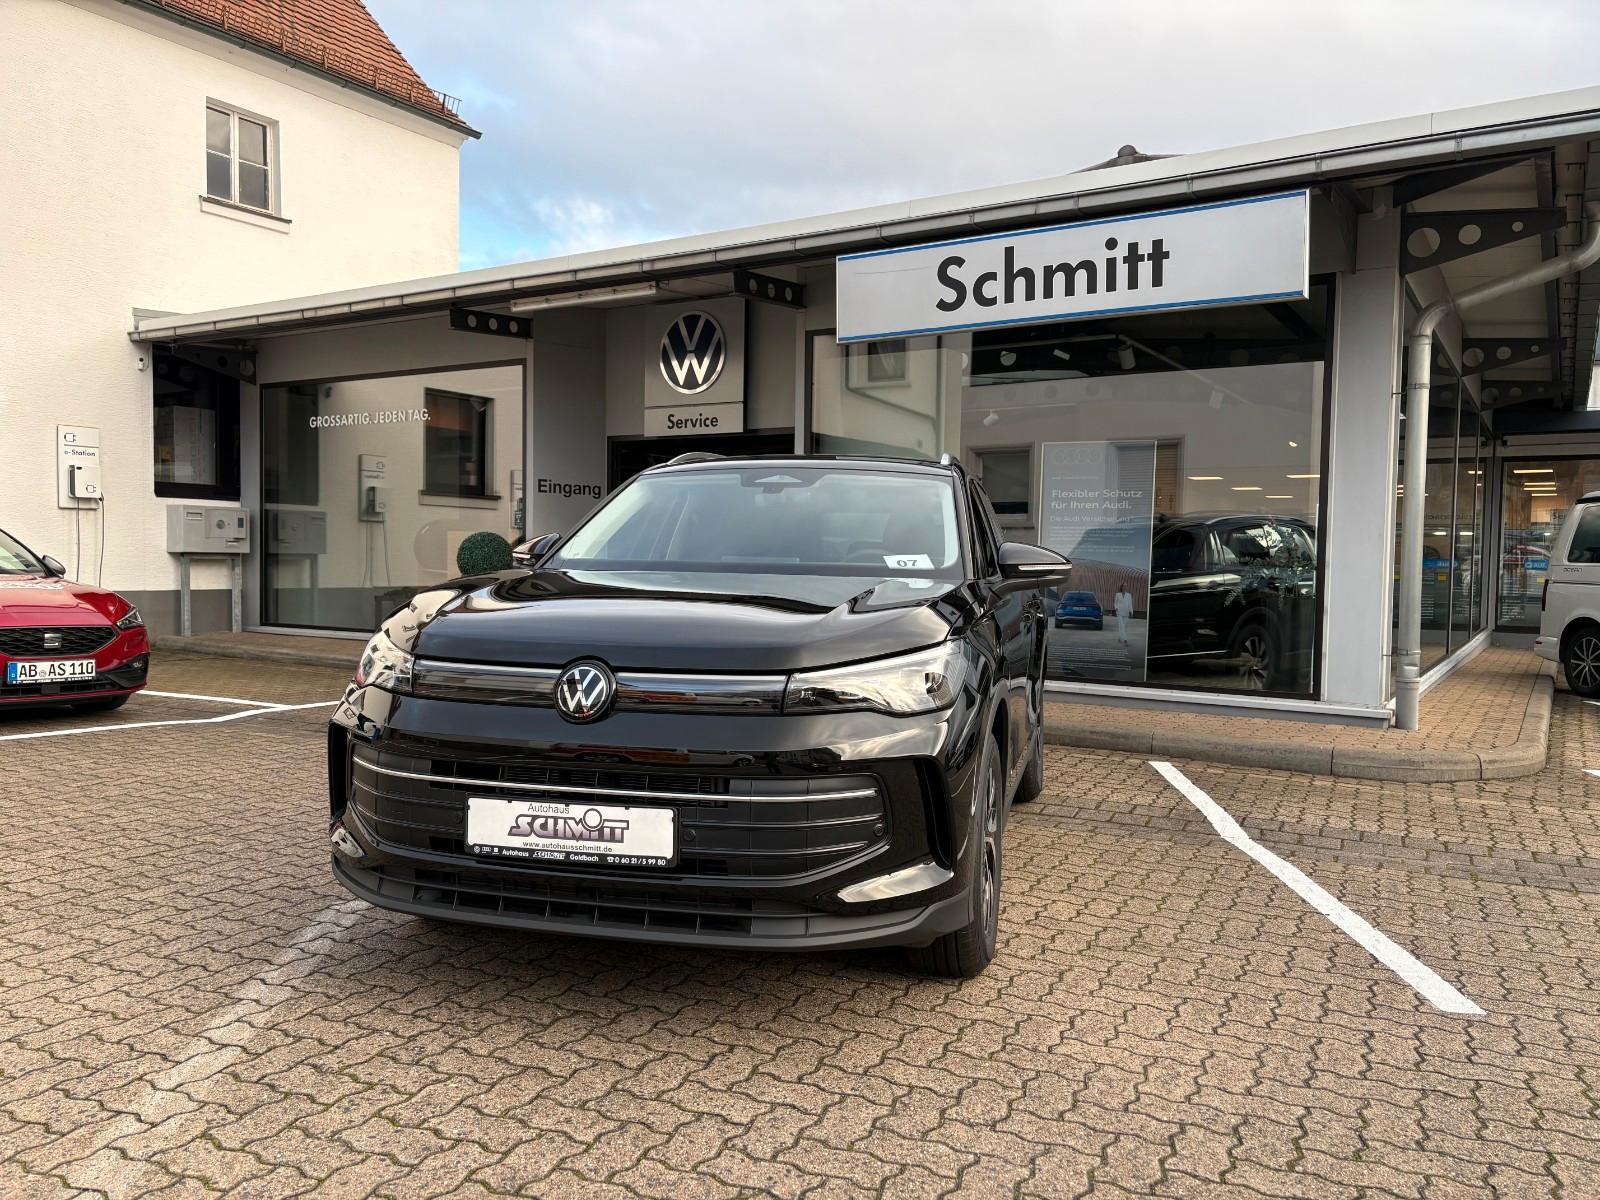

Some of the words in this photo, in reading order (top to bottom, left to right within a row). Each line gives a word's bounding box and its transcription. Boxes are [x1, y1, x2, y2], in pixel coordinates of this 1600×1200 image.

[935, 237, 1170, 312] Schmitt
[309, 412, 372, 428] GROSSARTIG.
[374, 410, 406, 424] JEDEN
[408, 408, 431, 421] TAG.
[667, 413, 719, 430] Service
[64, 448, 96, 457] e-Station
[537, 478, 601, 499] Eingang
[1052, 489, 1100, 498] Flexibler
[1103, 488, 1143, 498] Schutz
[1051, 500, 1066, 509] für
[1070, 500, 1099, 509] Ihren
[1102, 500, 1132, 509] Audi.
[896, 559, 918, 567] 07
[19, 664, 38, 678] AB
[48, 662, 66, 676] AS
[69, 661, 94, 675] 110
[528, 803, 570, 814] Autohaus
[522, 841, 613, 853] www.autohausschmitt.de
[502, 848, 529, 857] Autohaus
[570, 853, 599, 862] Goldbach
